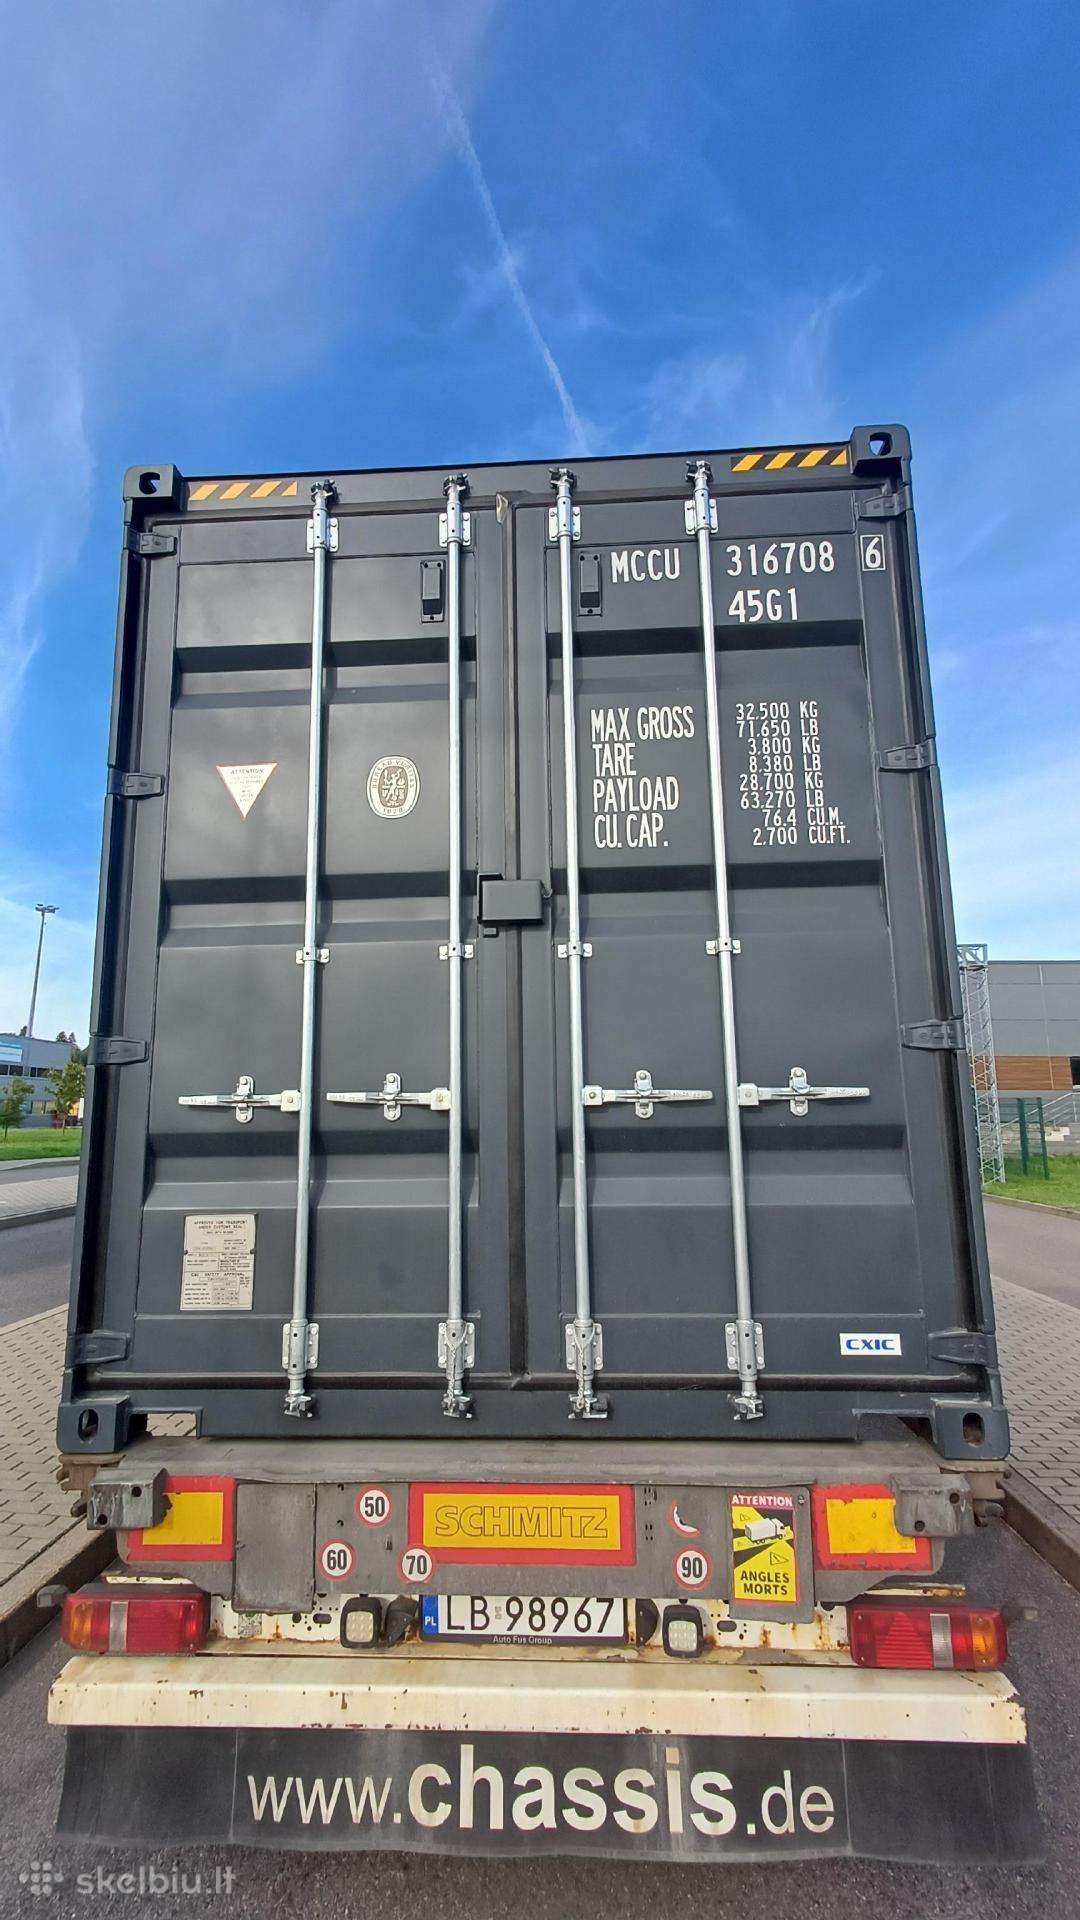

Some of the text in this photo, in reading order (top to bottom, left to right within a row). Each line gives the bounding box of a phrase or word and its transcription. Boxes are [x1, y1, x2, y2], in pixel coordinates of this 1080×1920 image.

[610, 537, 882, 583] MCCU 316708 6
[728, 587, 799, 623] 45G1
[800, 701, 818, 718] KG
[591, 706, 695, 742] MAX GROSS
[801, 719, 819, 736] LB
[802, 736, 821, 754] KG
[592, 742, 637, 777] TARE
[803, 754, 822, 772] LB
[805, 772, 824, 790] KG
[593, 776, 680, 813] PAYLOAD
[806, 790, 824, 807] LB
[762, 808, 797, 827] 76.4
[846, 1339, 895, 1351] CXIC
[364, 1496, 386, 1518] 50
[732, 1494, 793, 1507] ATTENTION
[435, 1505, 608, 1539] SCHMITZ
[327, 1549, 348, 1571] 60
[406, 1555, 427, 1575] 70
[681, 1556, 703, 1579] 90
[740, 1570, 790, 1584] ANGLES
[743, 1583, 788, 1596] MORTS
[424, 1616, 437, 1626] PL
[447, 1595, 615, 1634] LB 98967
[493, 1635, 553, 1645] Auto Fus Group
[247, 1744, 835, 1836] www.chassis.de
